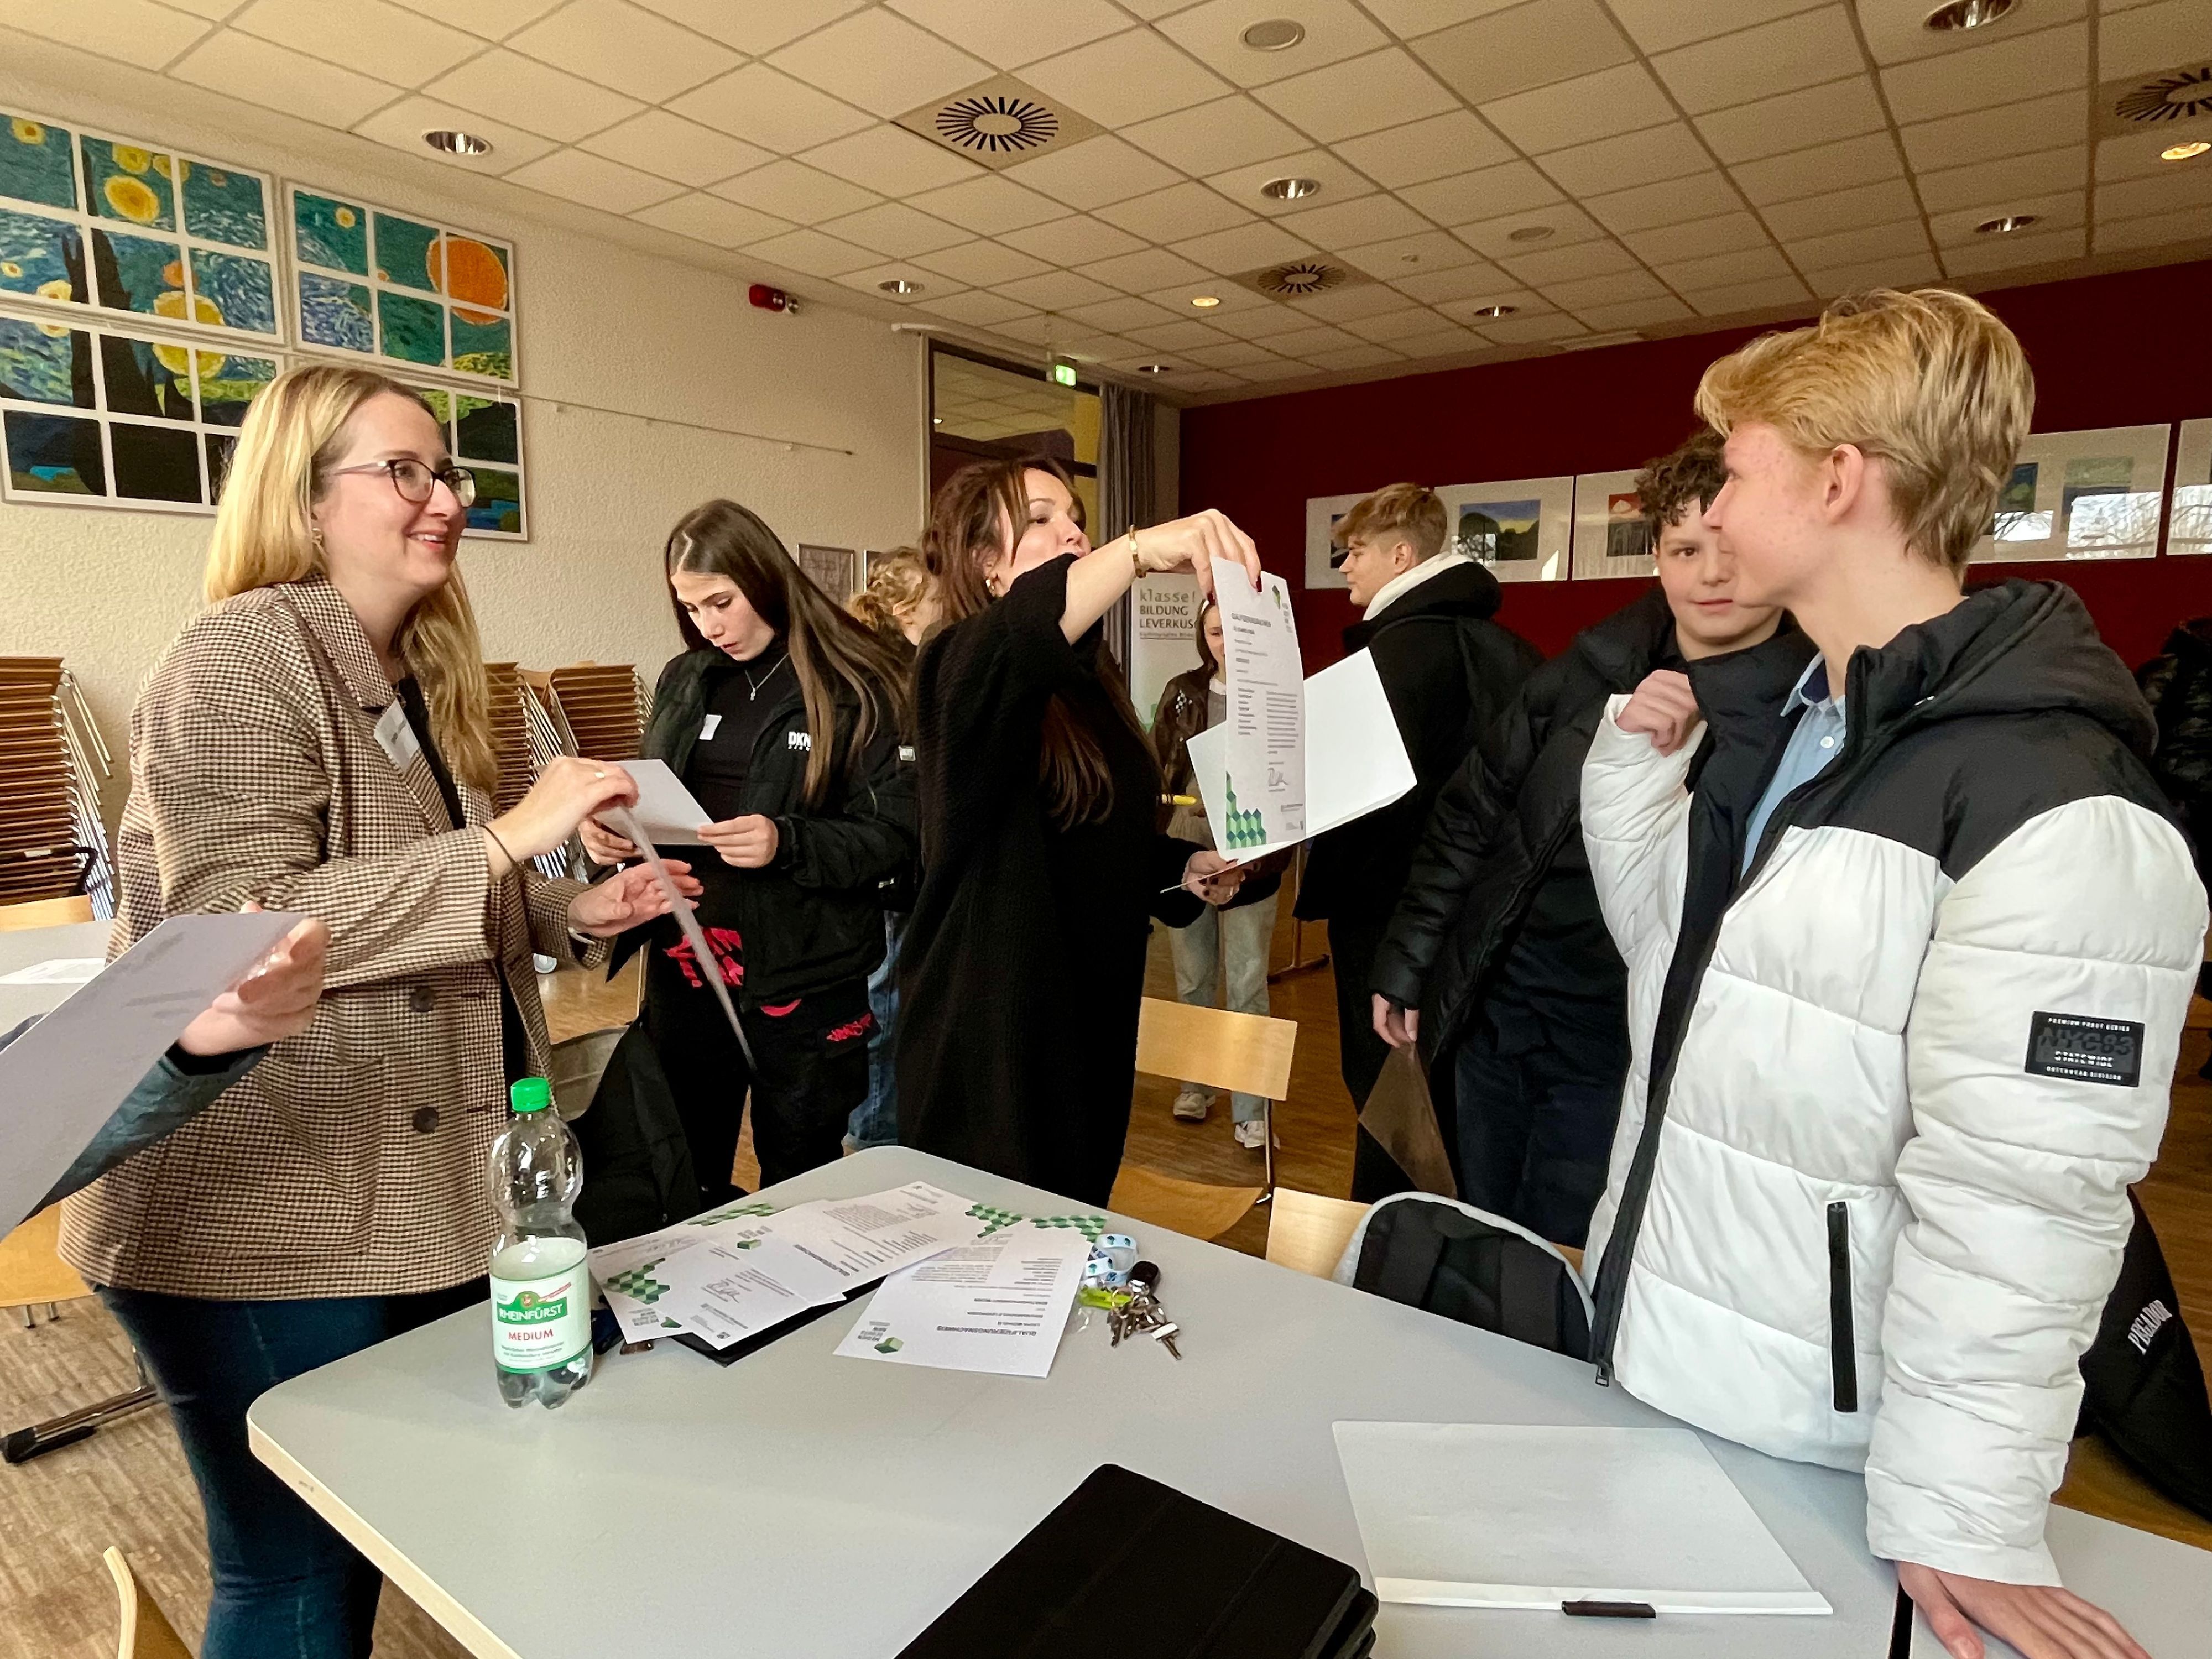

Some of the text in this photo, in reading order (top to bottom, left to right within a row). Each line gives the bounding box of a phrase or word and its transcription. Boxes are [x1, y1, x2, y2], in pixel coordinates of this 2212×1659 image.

[1139, 605, 1188, 615] BILDUNG
[1139, 619, 1194, 629] LEVERKUS
[788, 731, 811, 748] DKN
[499, 1303, 563, 1322] RHEINFÜRST
[508, 1328, 554, 1340] MEDIUM
